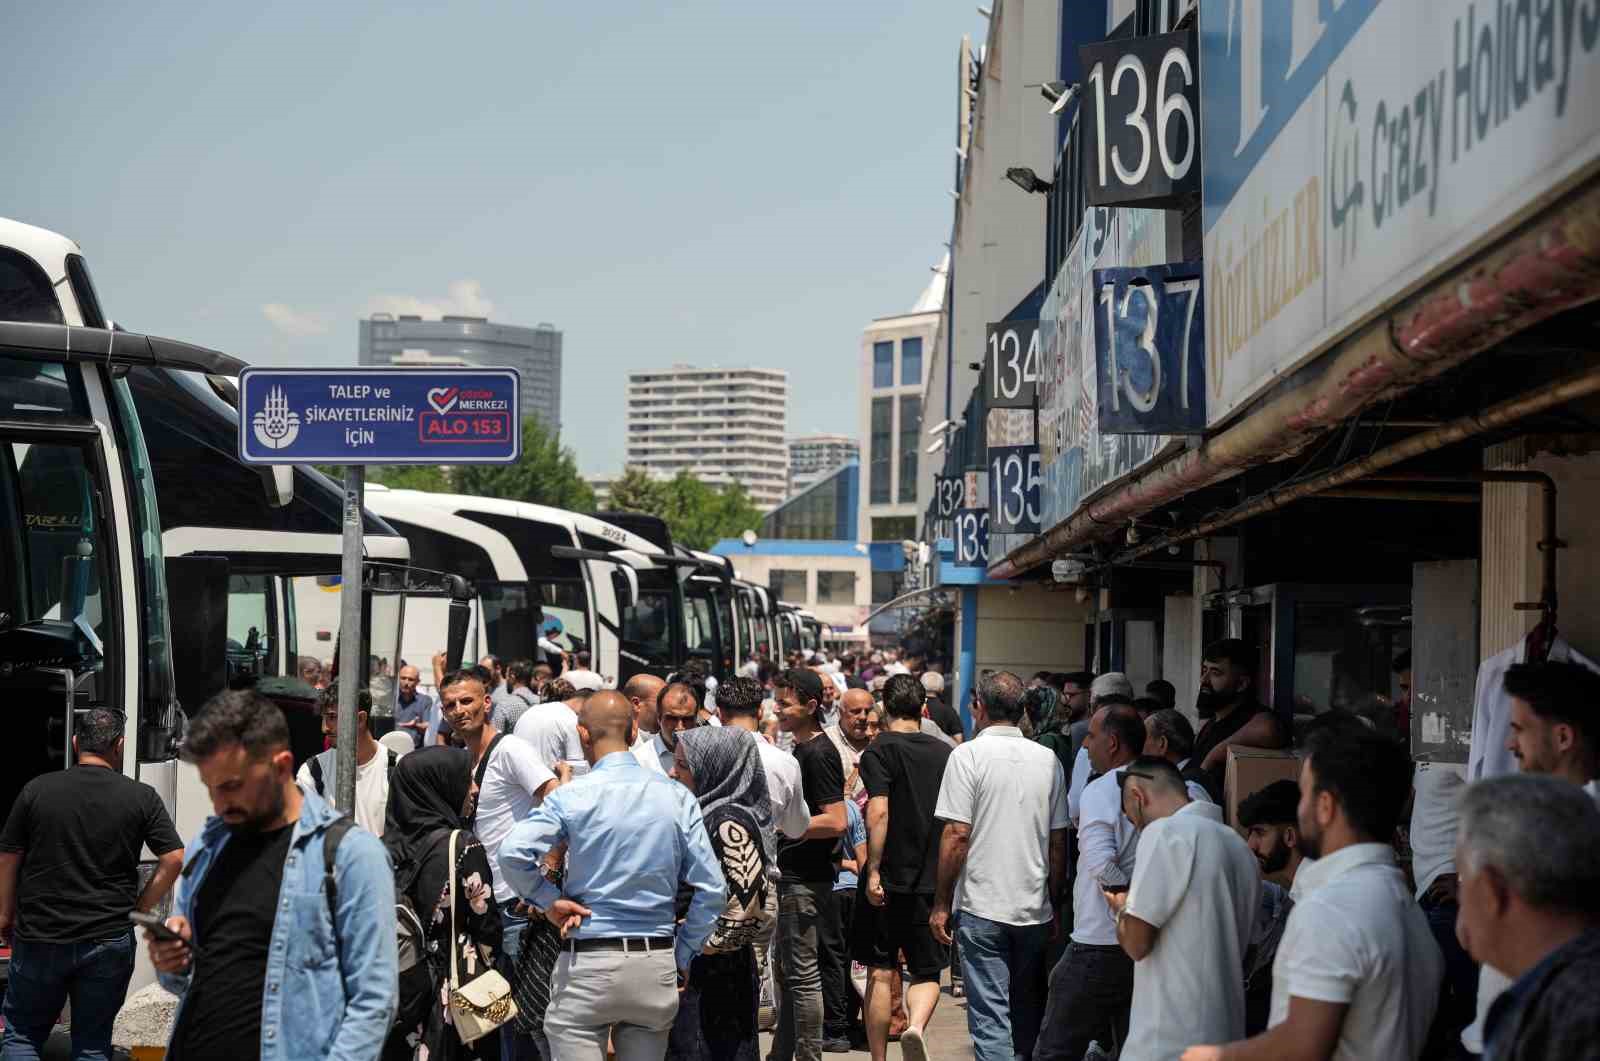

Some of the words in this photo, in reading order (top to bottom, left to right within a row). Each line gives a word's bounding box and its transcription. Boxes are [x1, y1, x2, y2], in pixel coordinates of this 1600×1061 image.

[1088, 47, 1195, 186] 136
[1371, 68, 1446, 230] Crazy
[989, 329, 1043, 400] 134
[1100, 279, 1200, 413] 137
[304, 404, 415, 424] ŞİKAYETLERİNİZ
[328, 385, 370, 399] TALEP
[374, 388, 391, 399] ve
[345, 427, 375, 447] İÇİN
[428, 419, 467, 435] ALO
[472, 419, 502, 435] 153
[936, 478, 965, 517] 132
[992, 453, 1041, 526] 135
